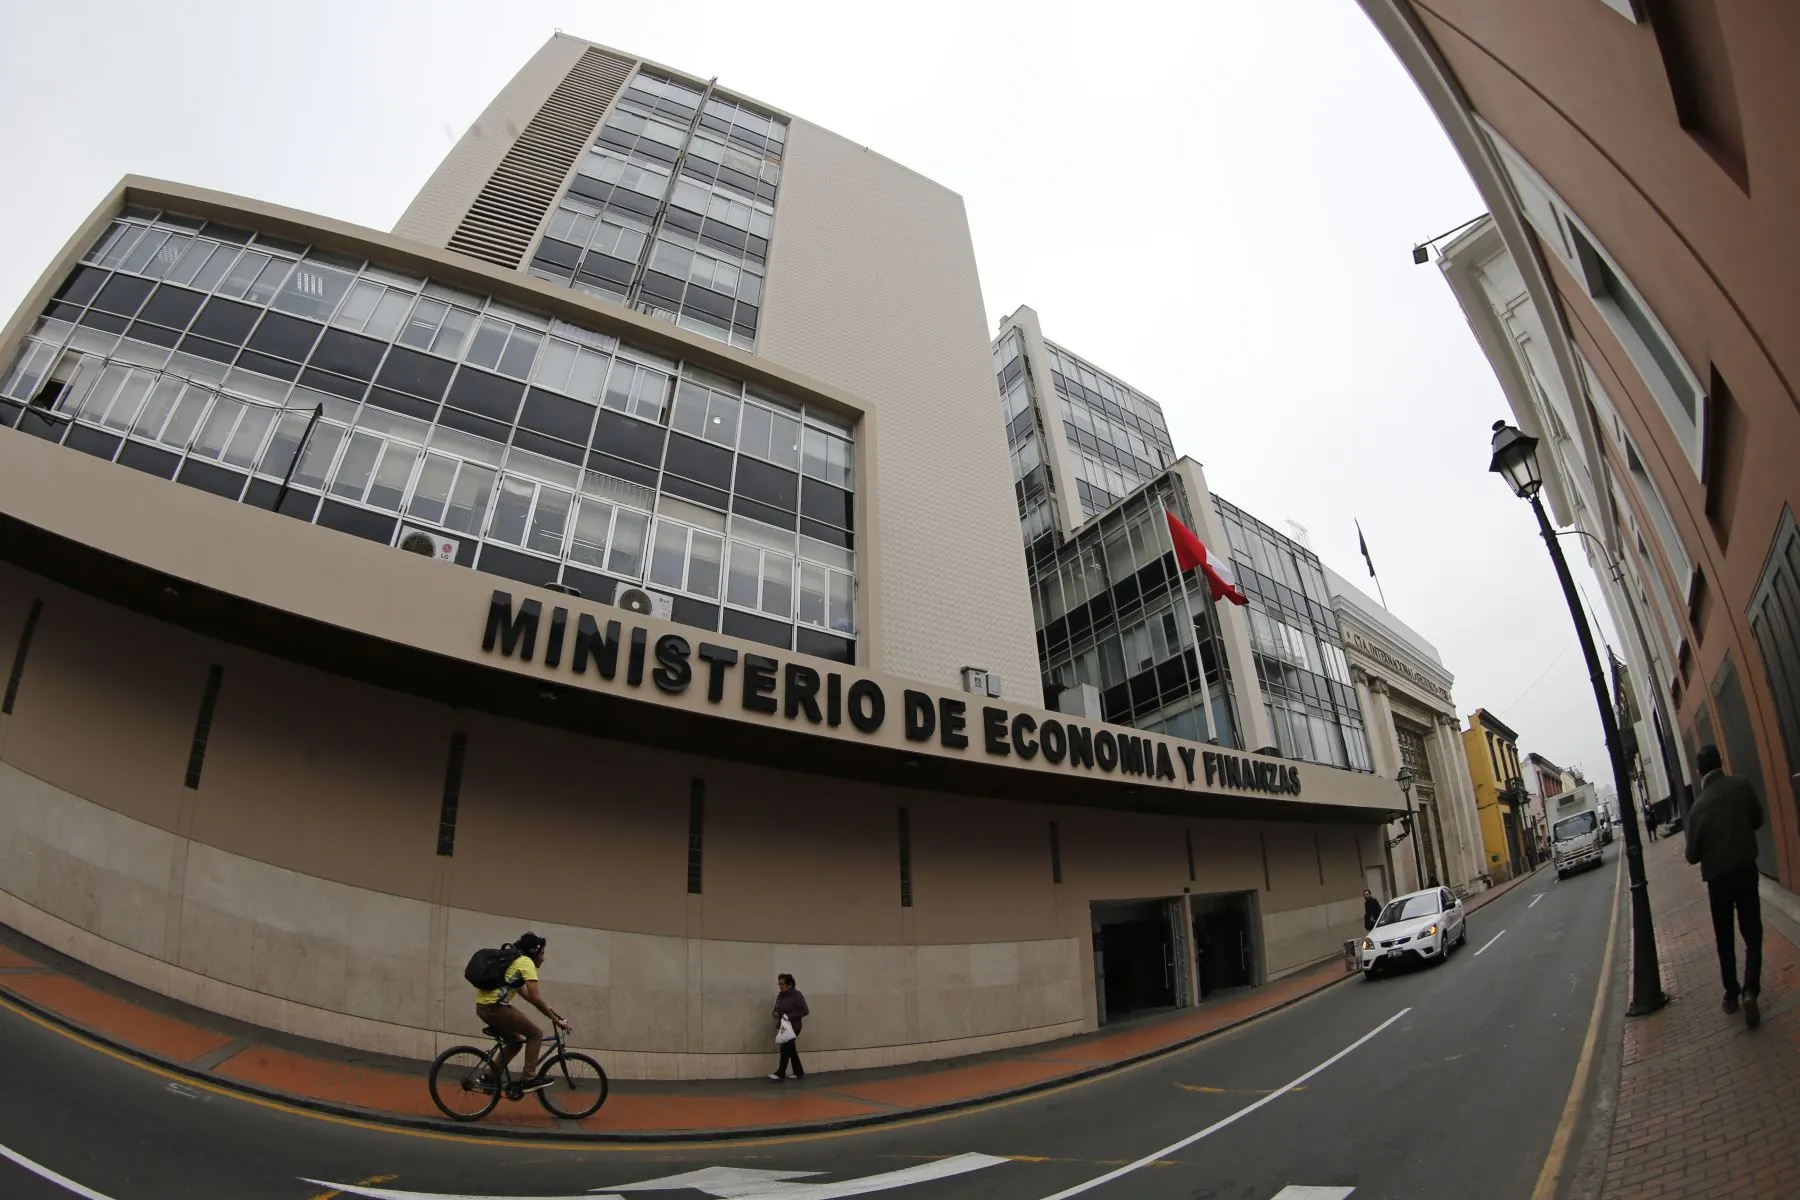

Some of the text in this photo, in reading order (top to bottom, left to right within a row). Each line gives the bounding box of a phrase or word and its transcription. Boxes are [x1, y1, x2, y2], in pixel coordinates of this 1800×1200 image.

[481, 590, 1301, 795] MINISTERIO DE ECONOMIA Y FINANZAS
